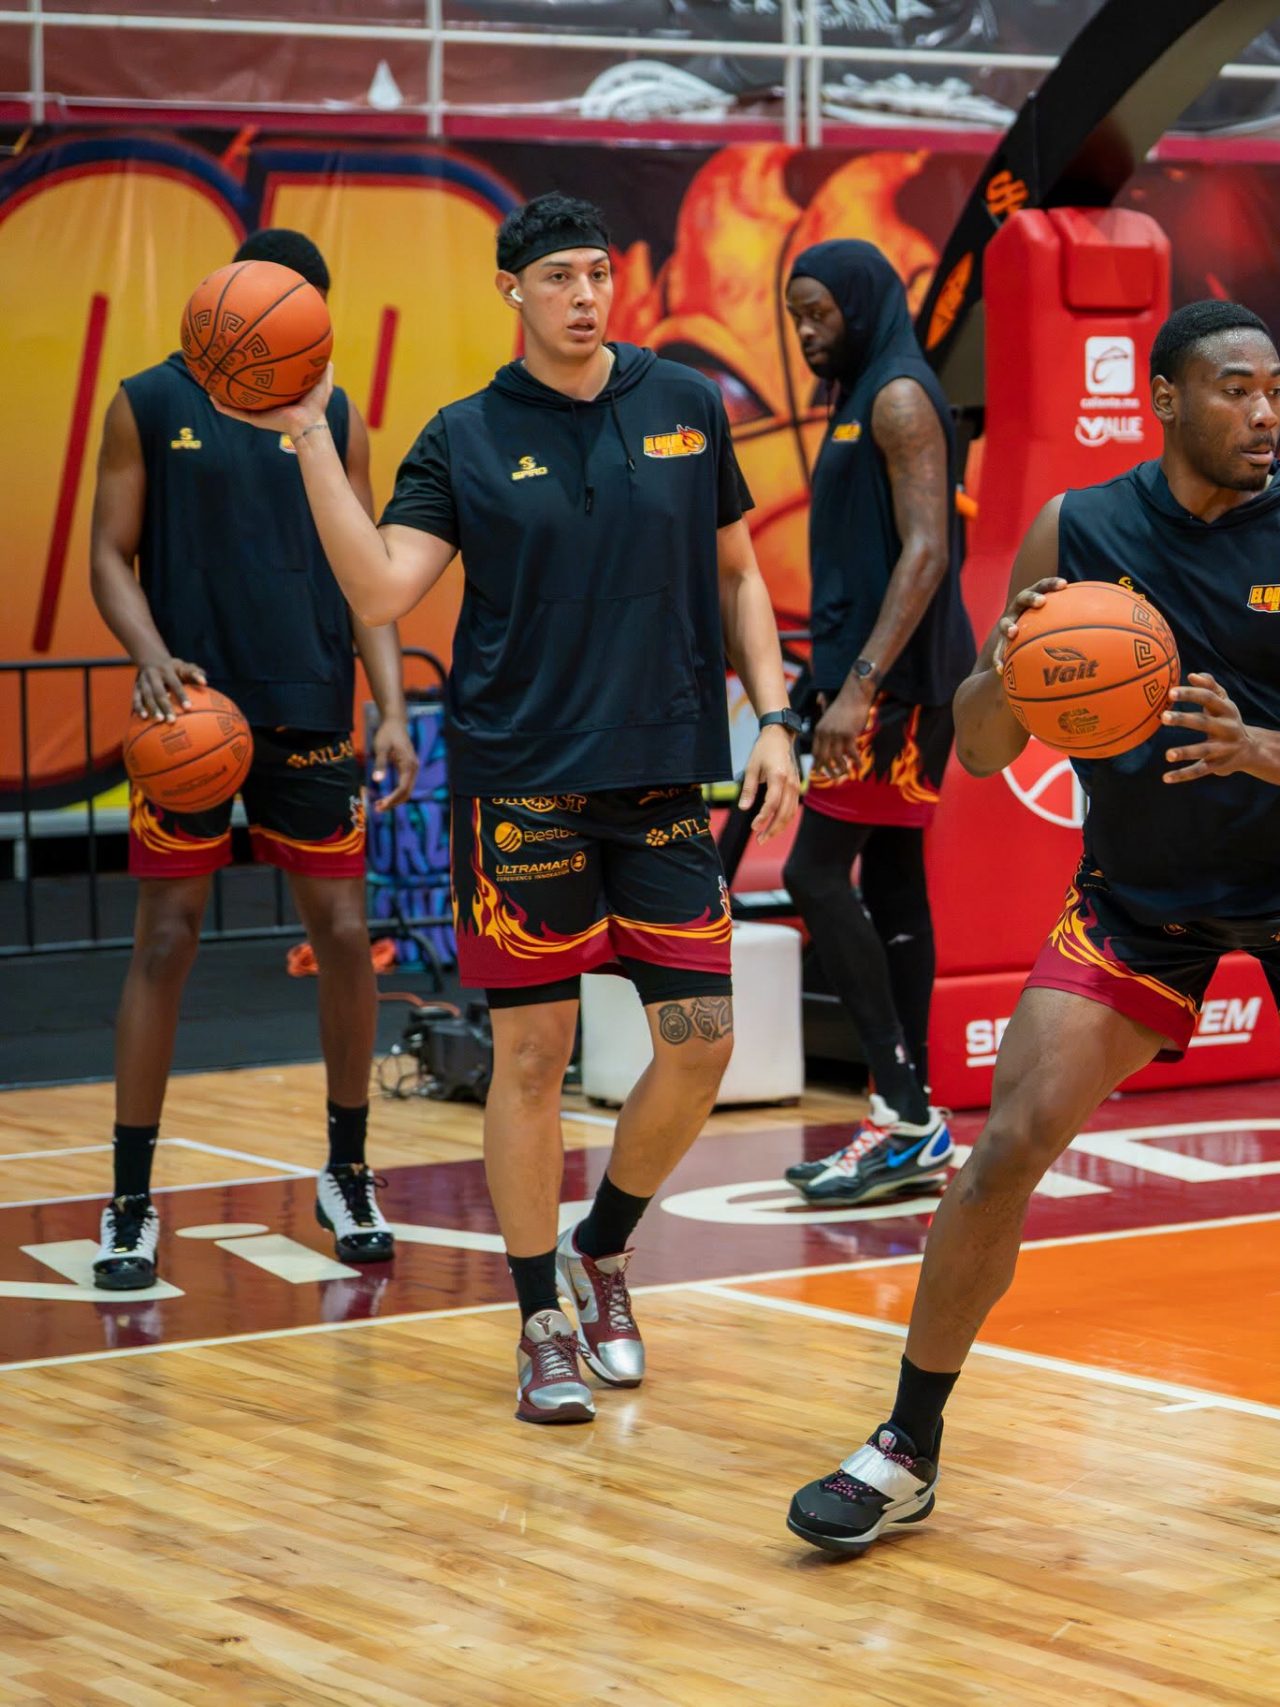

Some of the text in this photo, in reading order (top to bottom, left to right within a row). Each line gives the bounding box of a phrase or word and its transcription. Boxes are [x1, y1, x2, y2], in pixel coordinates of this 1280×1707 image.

[1043, 659, 1099, 687] Voit
[524, 829, 577, 843] Best
[671, 818, 710, 840] ATL
[496, 858, 569, 875] ULTRAMAR
